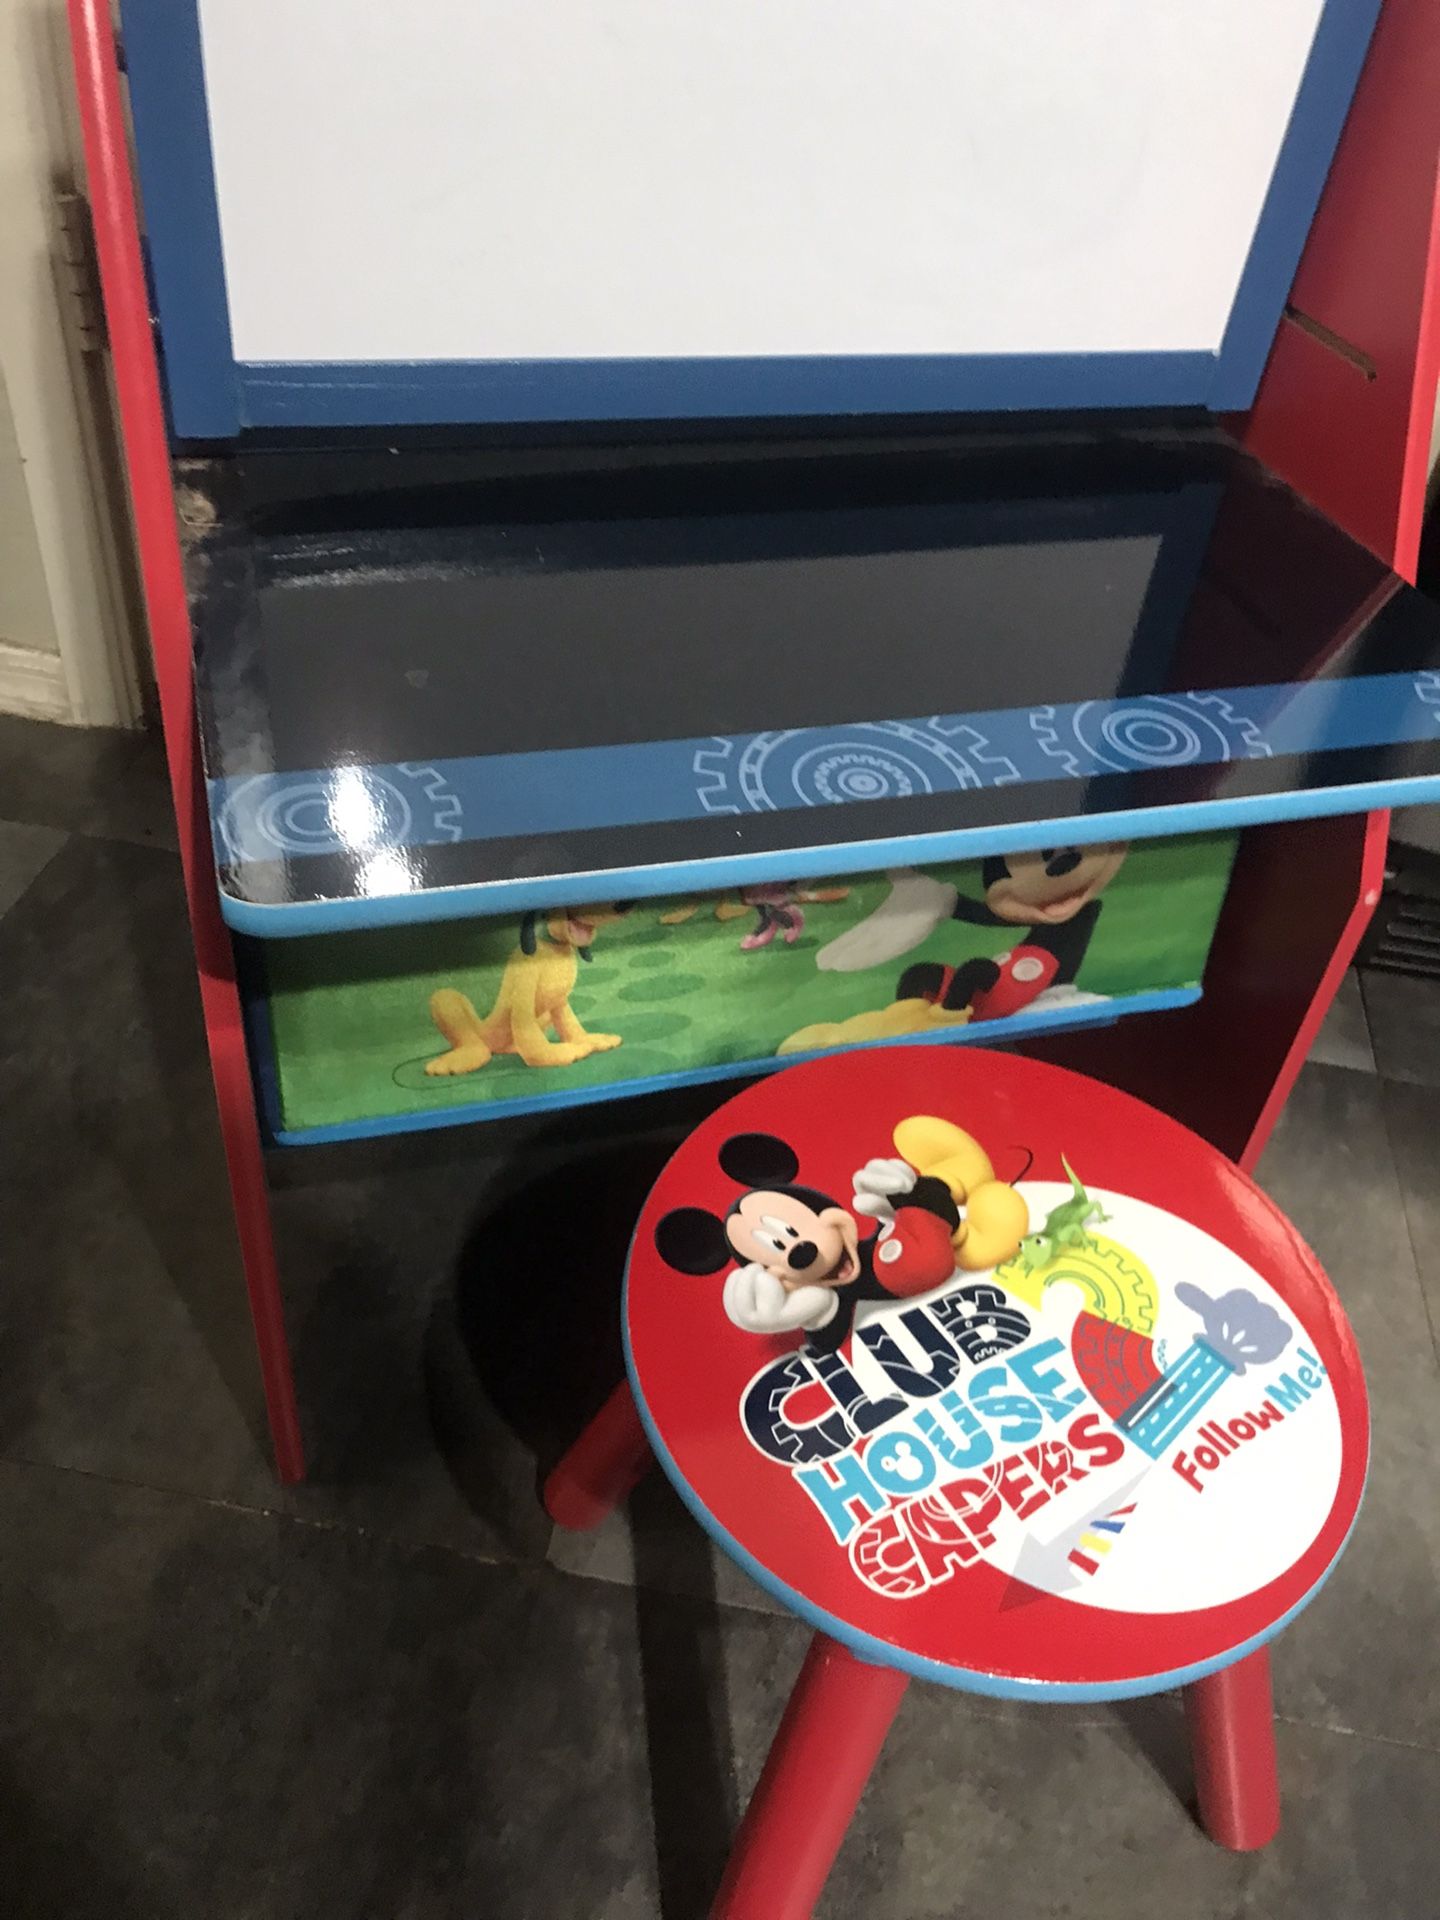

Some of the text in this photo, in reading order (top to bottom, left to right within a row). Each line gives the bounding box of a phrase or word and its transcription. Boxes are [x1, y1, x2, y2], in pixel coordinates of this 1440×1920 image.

[741, 1284, 1031, 1467] CLUB
[794, 1337, 1087, 1545] HOUSE
[1171, 1347, 1328, 1494] Follow Me!
[850, 1413, 1124, 1598] CAPERS
